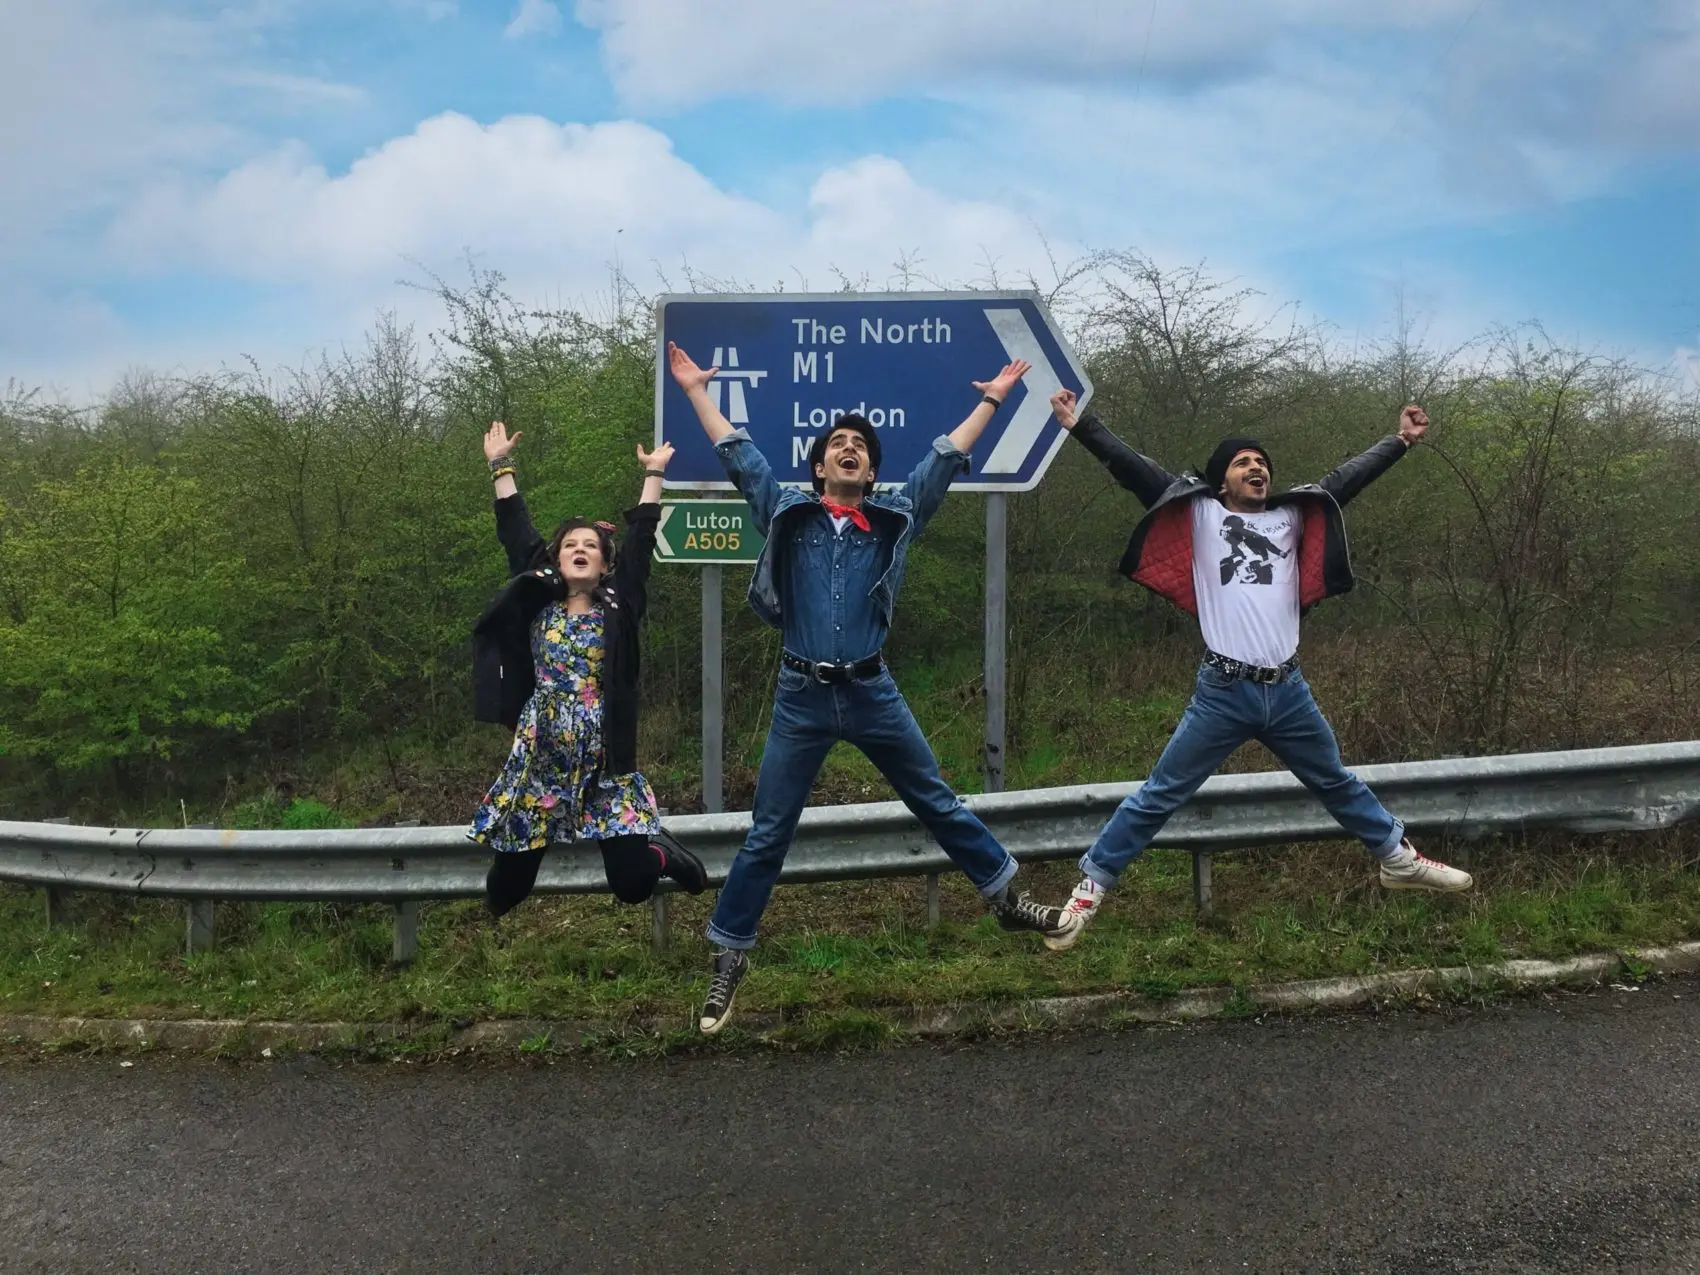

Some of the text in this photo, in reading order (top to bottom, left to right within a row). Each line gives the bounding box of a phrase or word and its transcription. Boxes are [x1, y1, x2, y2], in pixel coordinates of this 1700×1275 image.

[792, 317, 951, 344] The North
[793, 351, 833, 383] M1
[792, 436, 816, 468] M
[686, 511, 742, 529] Luton
[684, 532, 740, 550] A505
